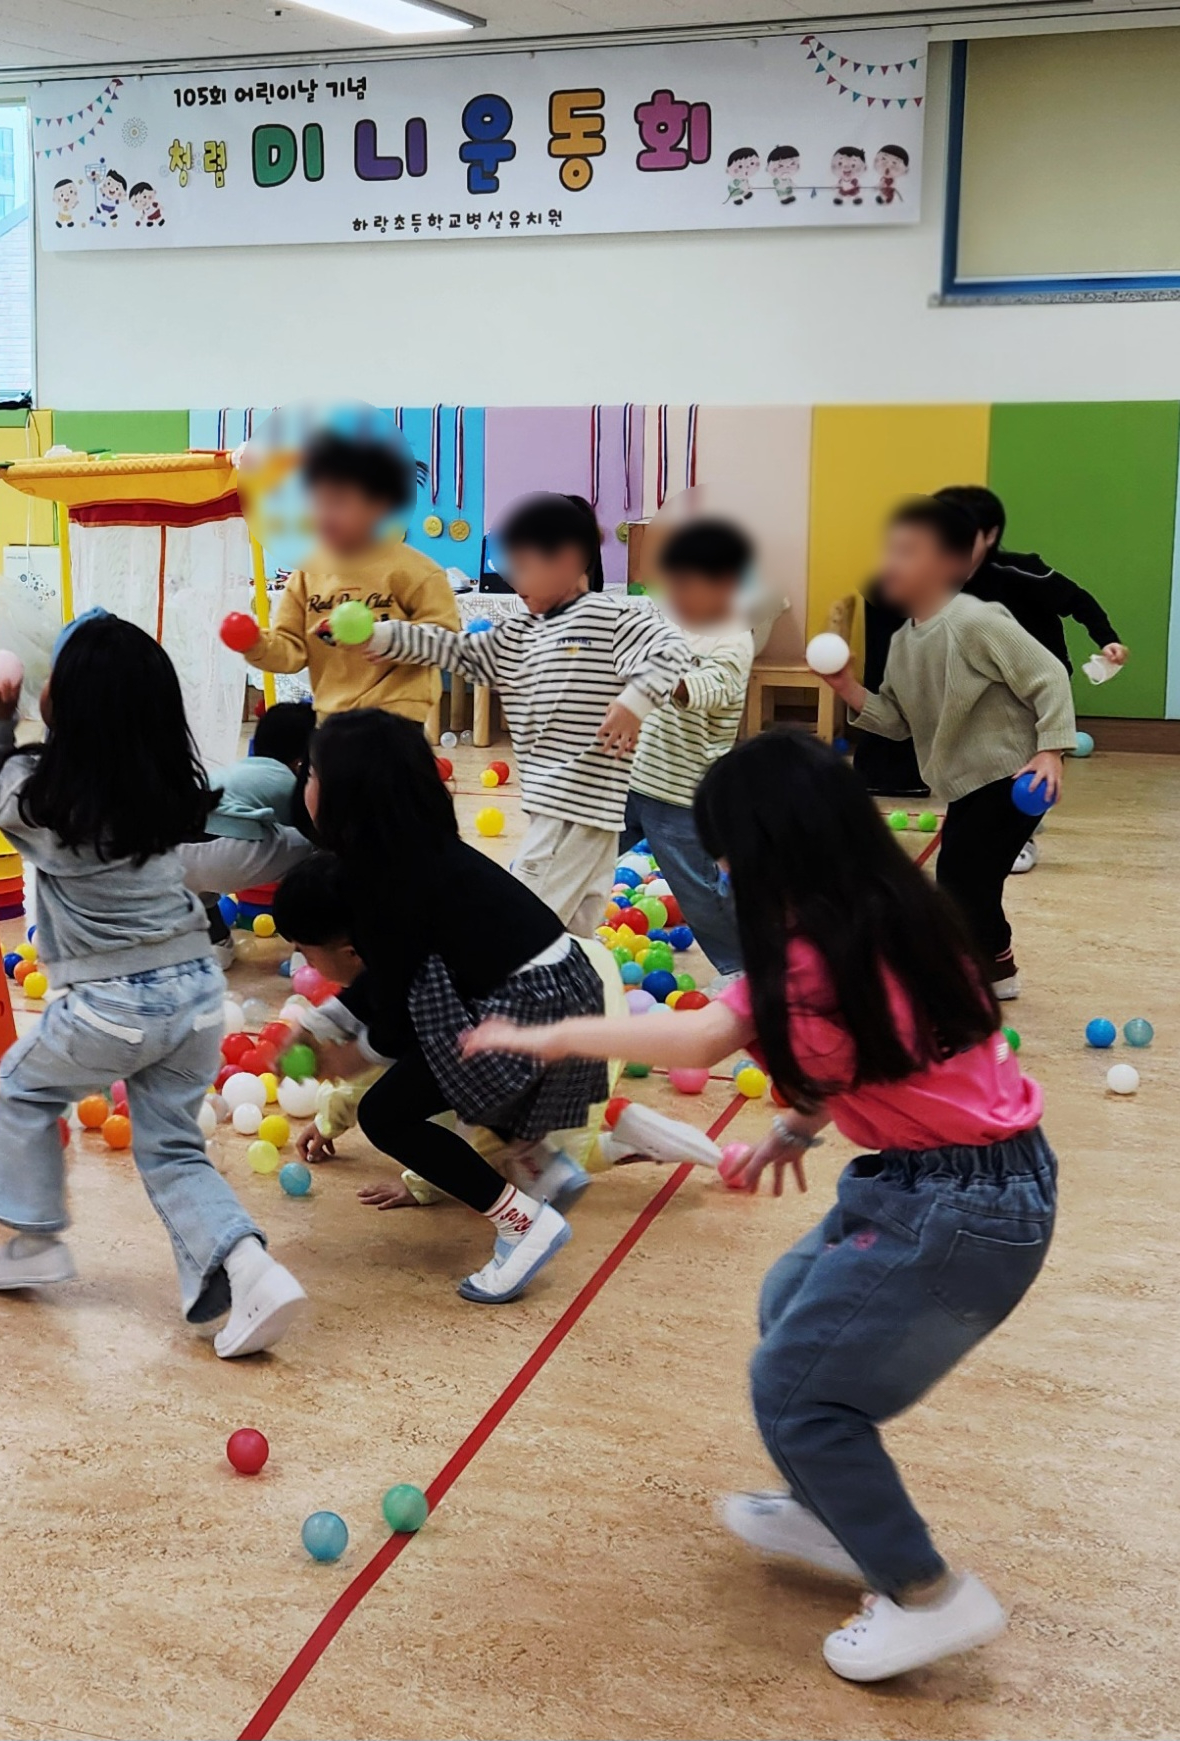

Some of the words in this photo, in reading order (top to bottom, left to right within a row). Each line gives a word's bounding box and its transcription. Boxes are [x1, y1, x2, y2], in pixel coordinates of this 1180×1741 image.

[173, 85, 227, 107] 105회
[234, 79, 319, 104] 어린이날
[326, 76, 367, 100] 기념
[168, 138, 228, 188] 청렴
